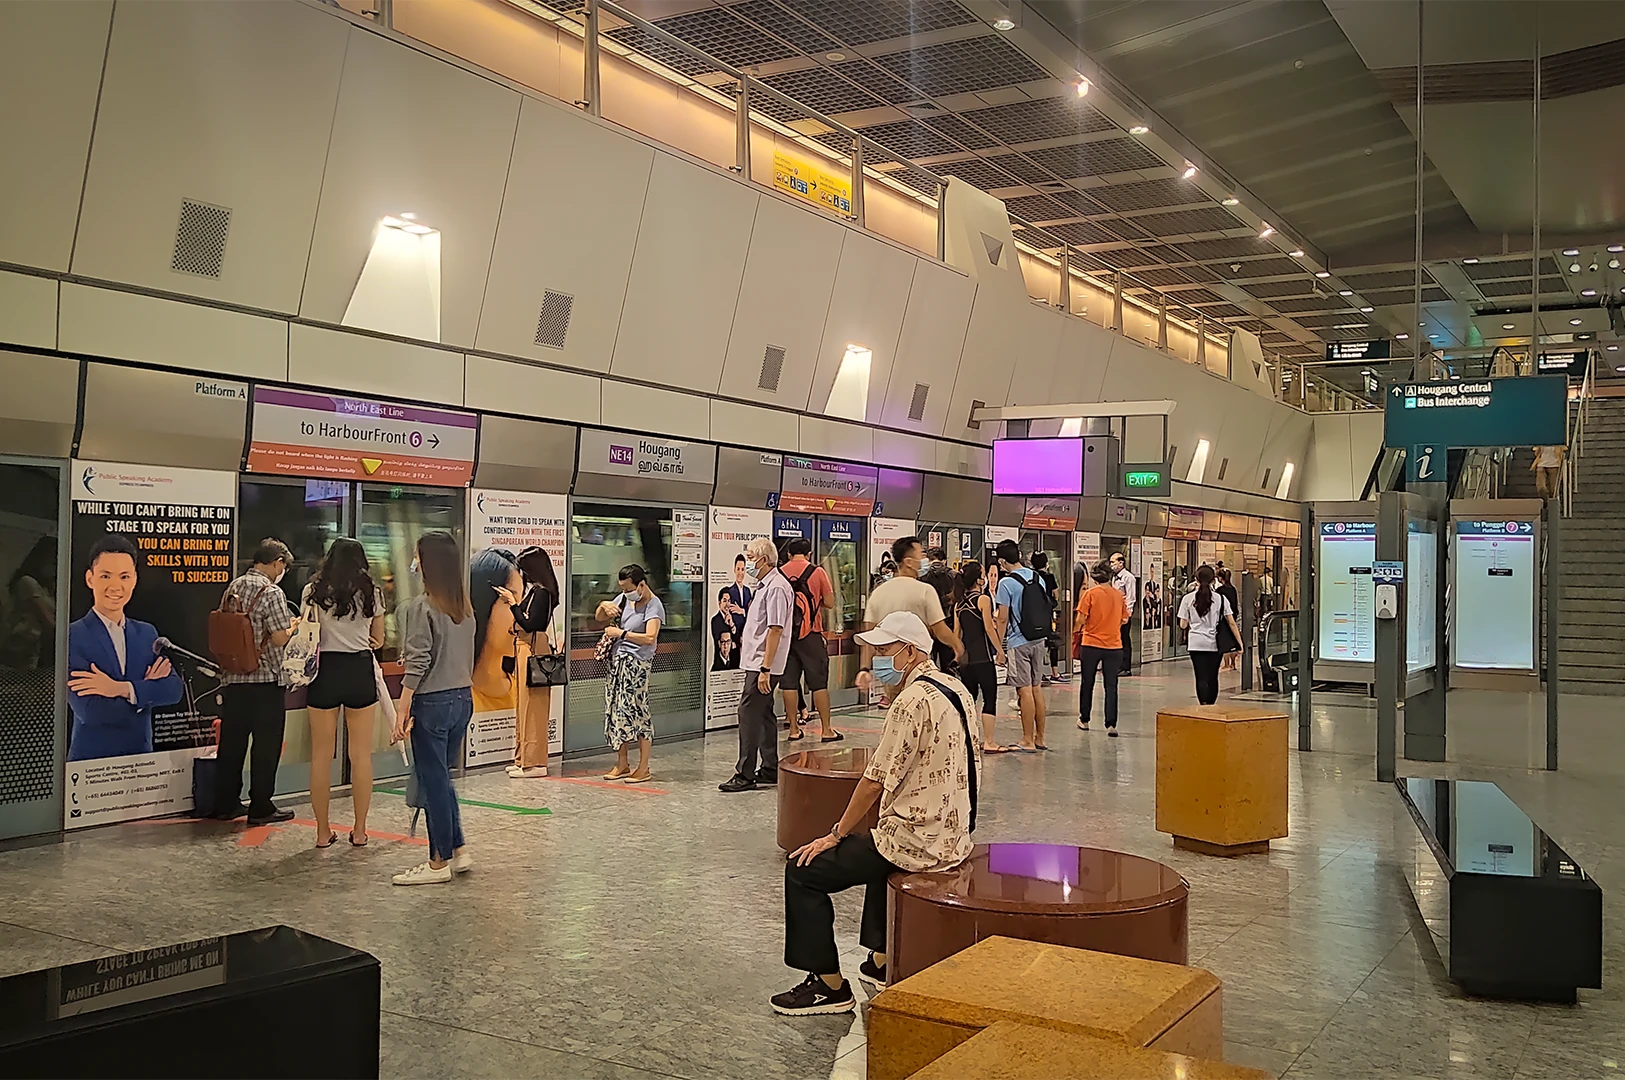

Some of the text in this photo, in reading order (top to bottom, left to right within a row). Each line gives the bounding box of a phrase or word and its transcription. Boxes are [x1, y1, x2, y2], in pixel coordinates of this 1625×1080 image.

[195, 382, 246, 399] Platform A
[1406, 382, 1492, 396] A Hougang Central
[1417, 395, 1490, 407] Bus Interchange
[344, 401, 404, 417] North East Line
[300, 421, 421, 447] to HarbourFront 6
[610, 449, 632, 462] NE14
[640, 441, 681, 459] Hougang
[761, 454, 776, 464] Platform
[802, 477, 808, 486] to
[809, 478, 846, 490] HarbourFront
[1129, 476, 1148, 486] EXIT
[77, 502, 230, 519] WHILE YOU CAN'T BRING ME ON
[489, 516, 503, 524] WANT
[517, 517, 531, 525] CHILD
[538, 518, 553, 526] SPEAK
[106, 520, 230, 535] STAGE TO SPEAK FOR YOU
[484, 526, 515, 535] CONFIDENCE?
[516, 527, 530, 535] TRAIN
[531, 528, 542, 536] WITH
[544, 528, 552, 536] THE
[492, 537, 564, 547] SINGAPOREAN WORLD CHAMPION
[712, 532, 723, 540] MEET
[736, 533, 750, 541] PUBLIC
[137, 537, 230, 551] YOU CAN BRING MY
[147, 555, 229, 567] SKILLS WITH YOU
[552, 559, 564, 567] TEAM
[172, 571, 229, 583] TO SUCCEED
